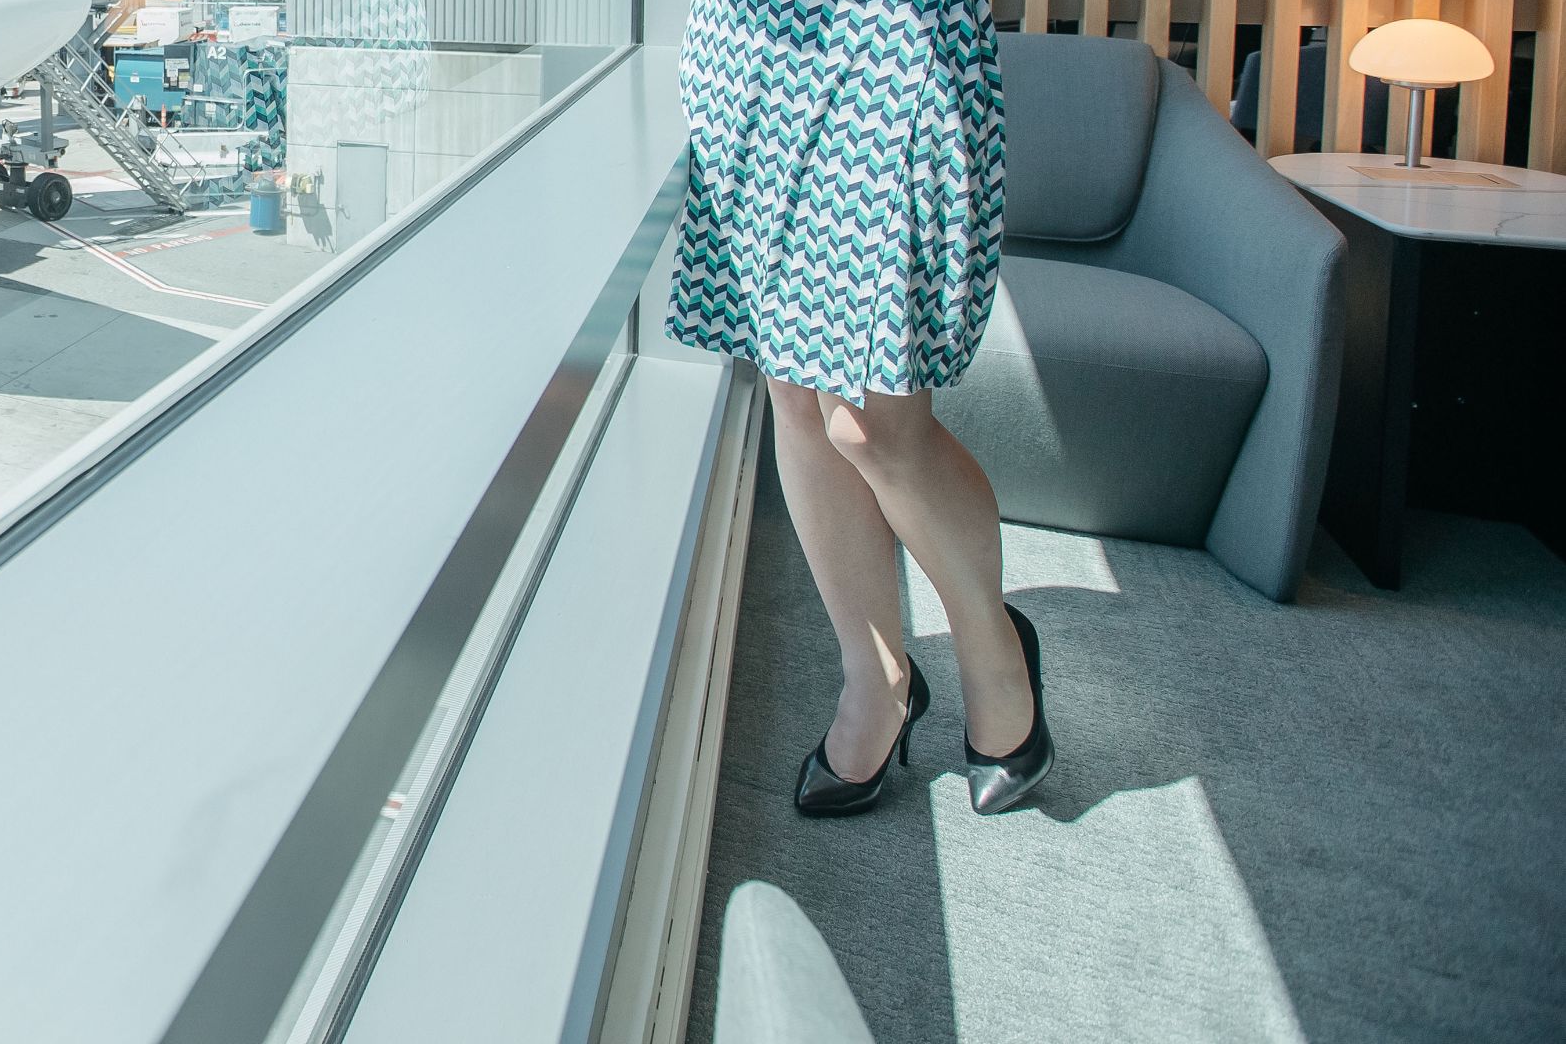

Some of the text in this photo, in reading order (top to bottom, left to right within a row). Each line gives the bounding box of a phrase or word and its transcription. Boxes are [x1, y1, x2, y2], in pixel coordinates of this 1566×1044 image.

[207, 46, 227, 60] A2
[123, 234, 213, 256] NO PARKING
